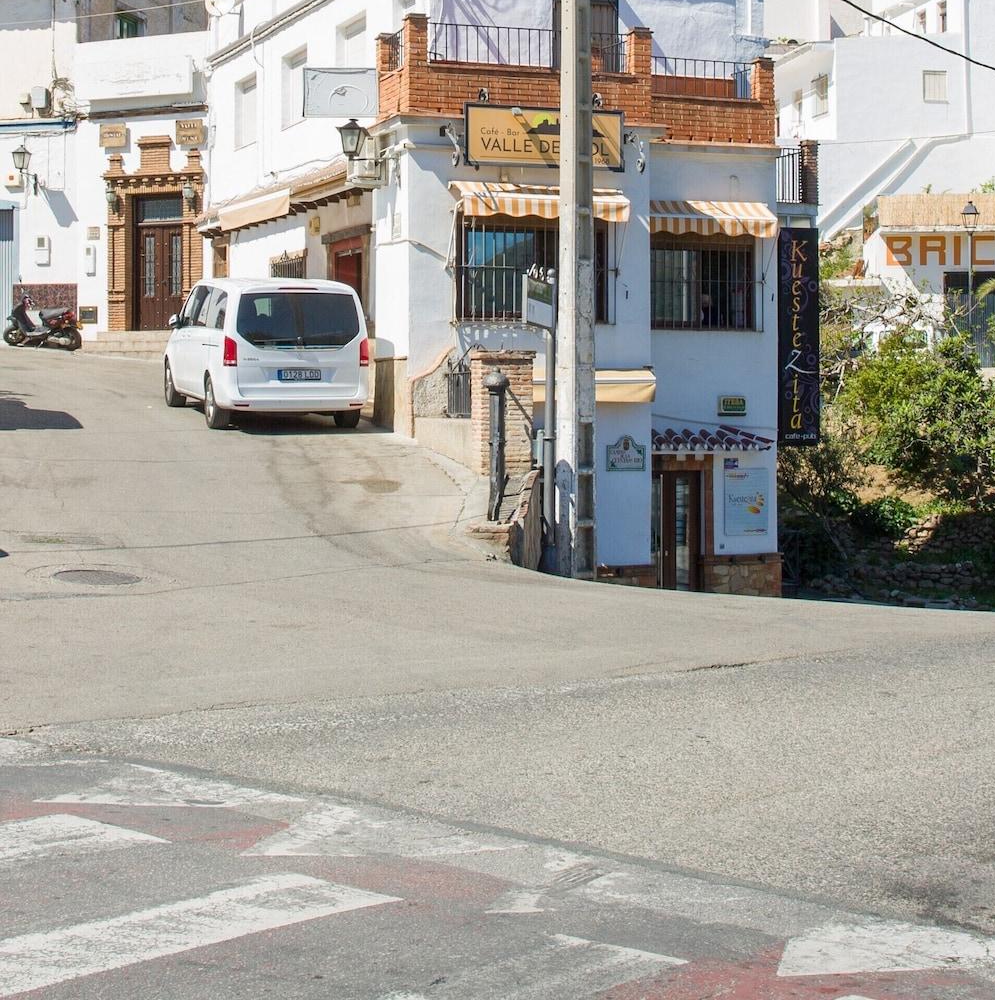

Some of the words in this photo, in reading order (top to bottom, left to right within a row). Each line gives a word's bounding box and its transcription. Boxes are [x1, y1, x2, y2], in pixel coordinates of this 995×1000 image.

[480, 127, 499, 136] Café
[507, 128, 520, 136] Bar
[480, 137, 533, 153] VALLE
[540, 139, 560, 154] DE
